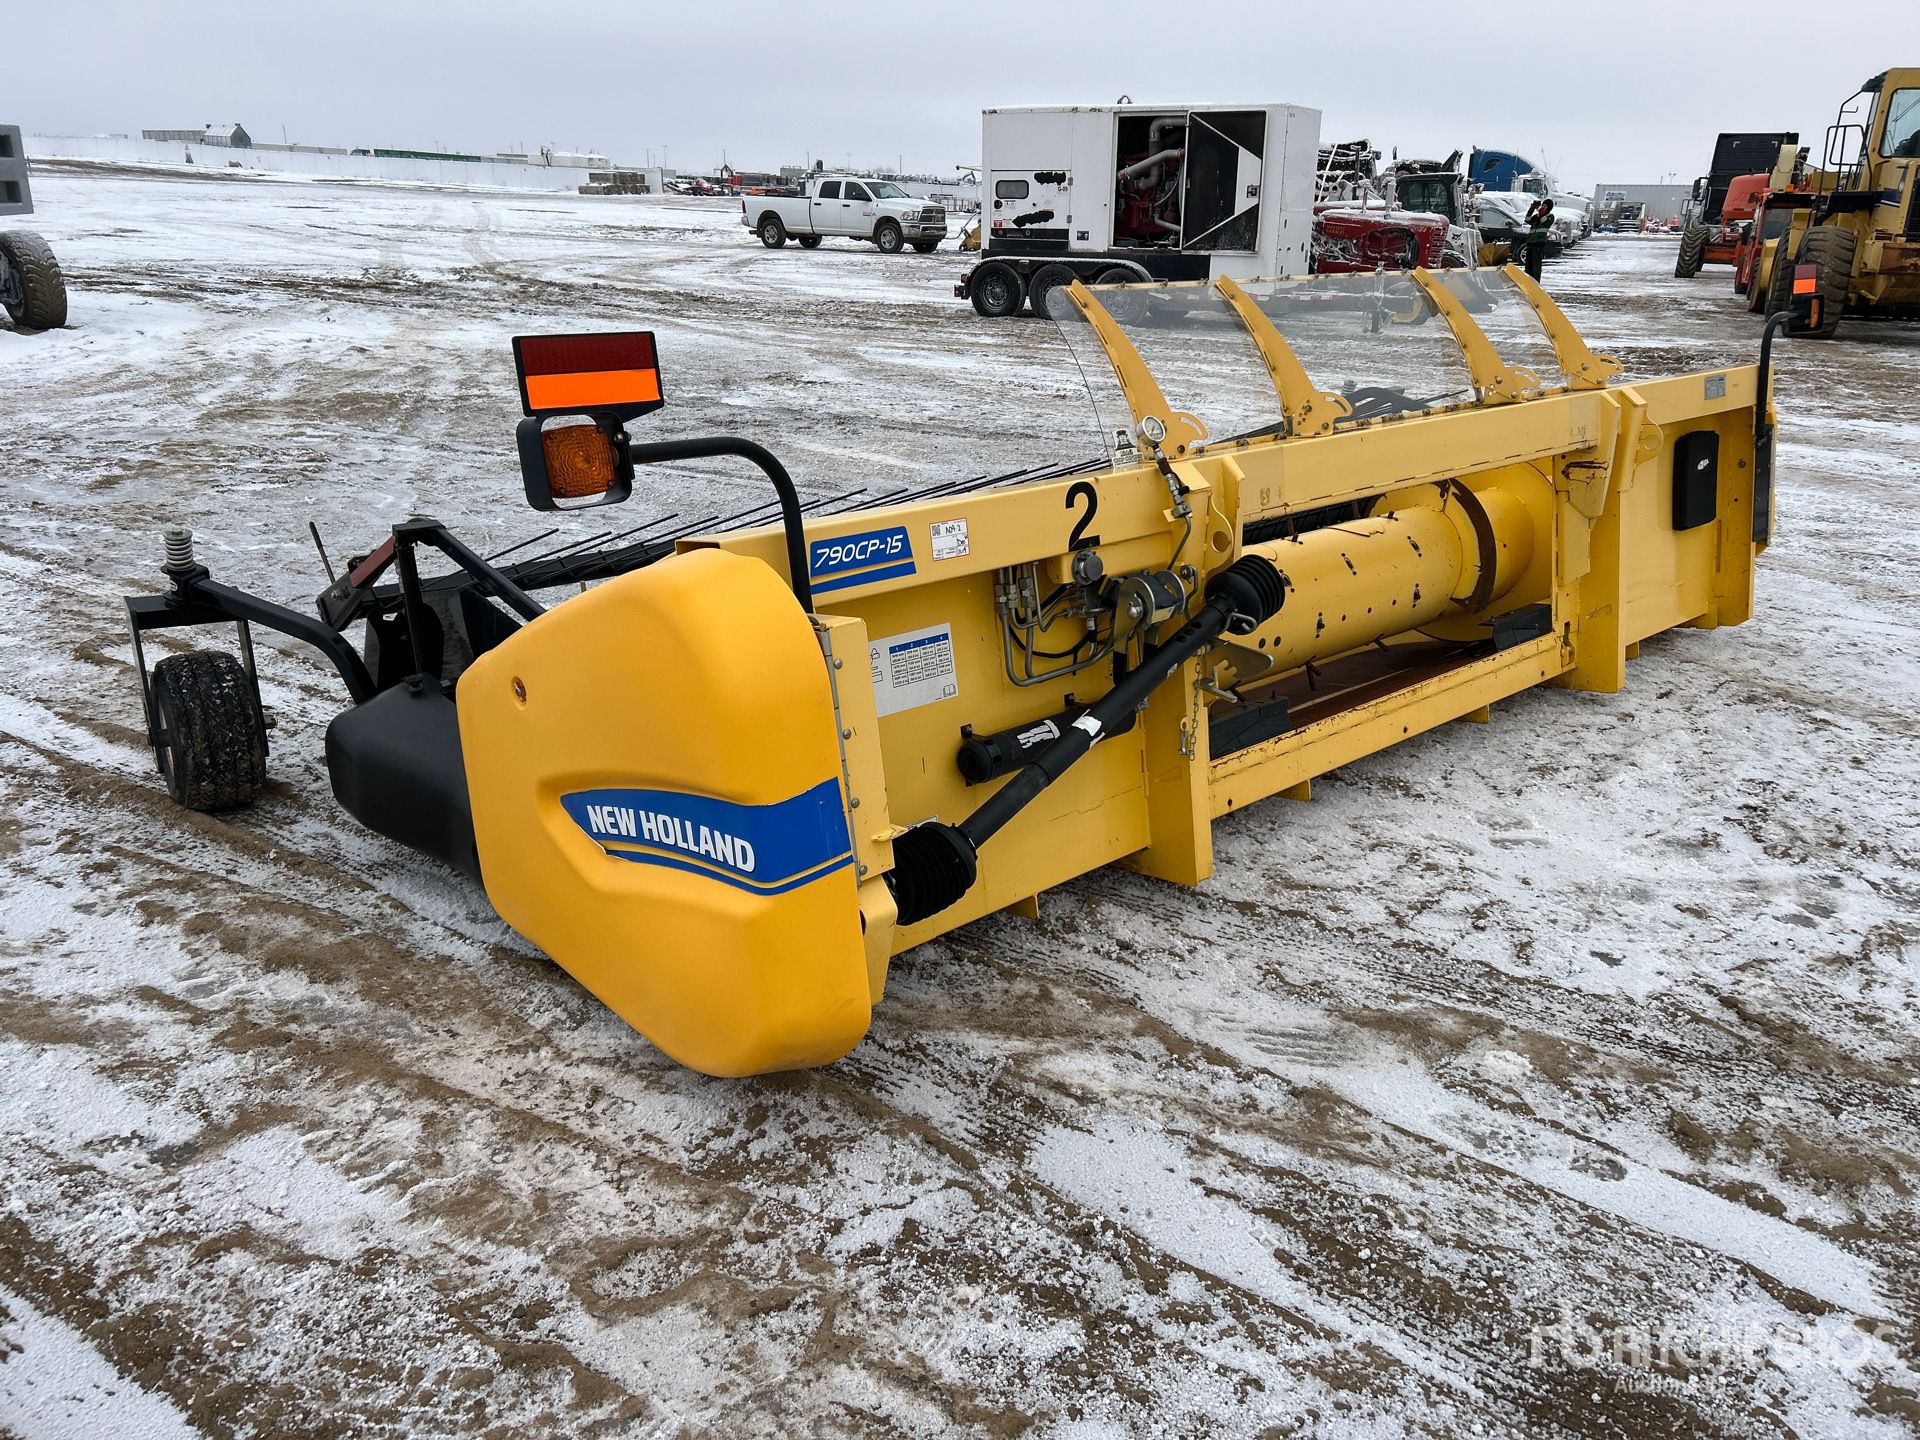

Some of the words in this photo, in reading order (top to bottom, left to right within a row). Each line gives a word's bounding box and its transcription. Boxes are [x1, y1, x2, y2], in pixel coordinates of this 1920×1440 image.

[1065, 481, 1101, 552] 2
[814, 534, 904, 569] 790CP-15
[587, 804, 637, 838] NEW
[639, 810, 756, 873] HOLLAND
